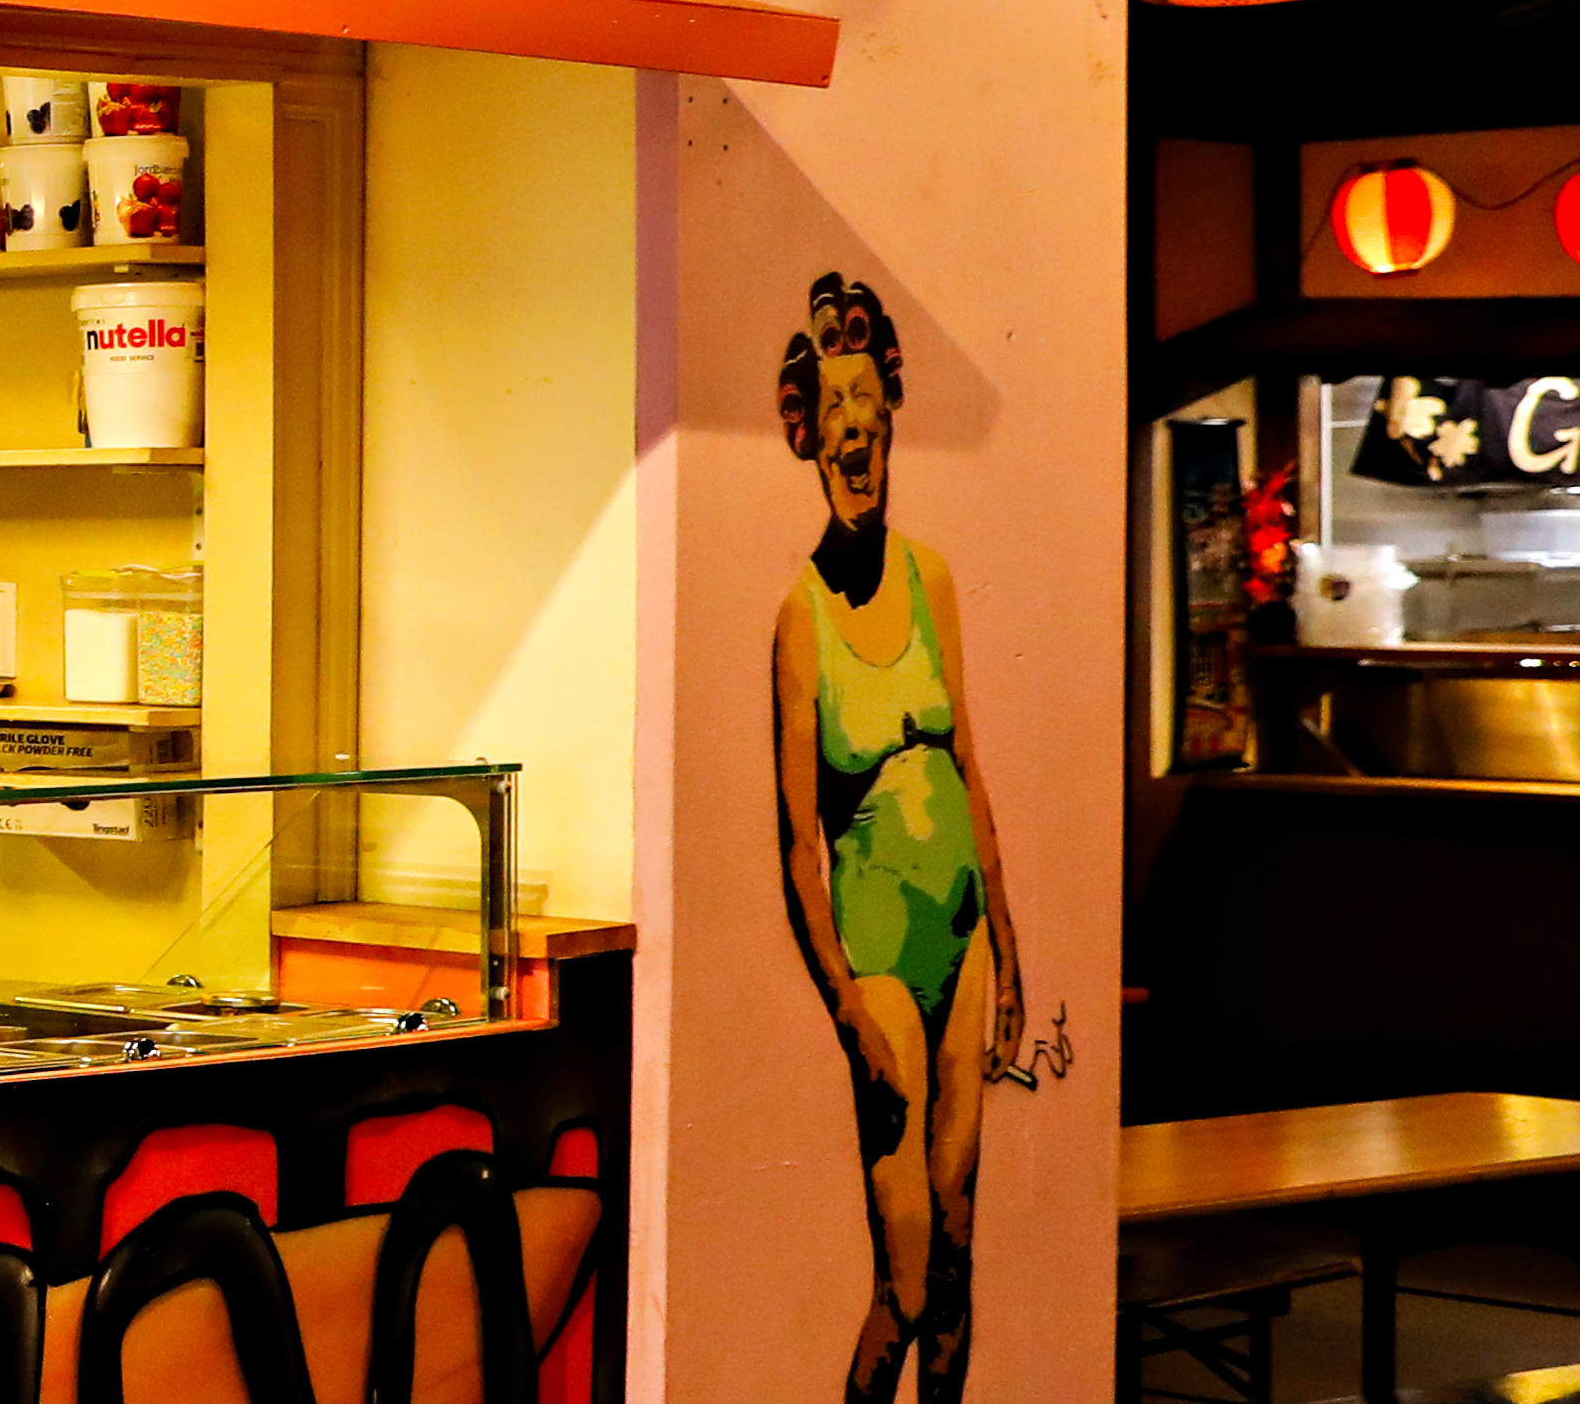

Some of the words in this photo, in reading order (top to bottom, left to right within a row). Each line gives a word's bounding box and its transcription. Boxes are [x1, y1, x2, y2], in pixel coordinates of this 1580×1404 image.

[87, 318, 186, 350] nutella
[26, 732, 66, 746] GLOVE
[17, 744, 65, 756] POWDER
[66, 747, 93, 758] FREE
